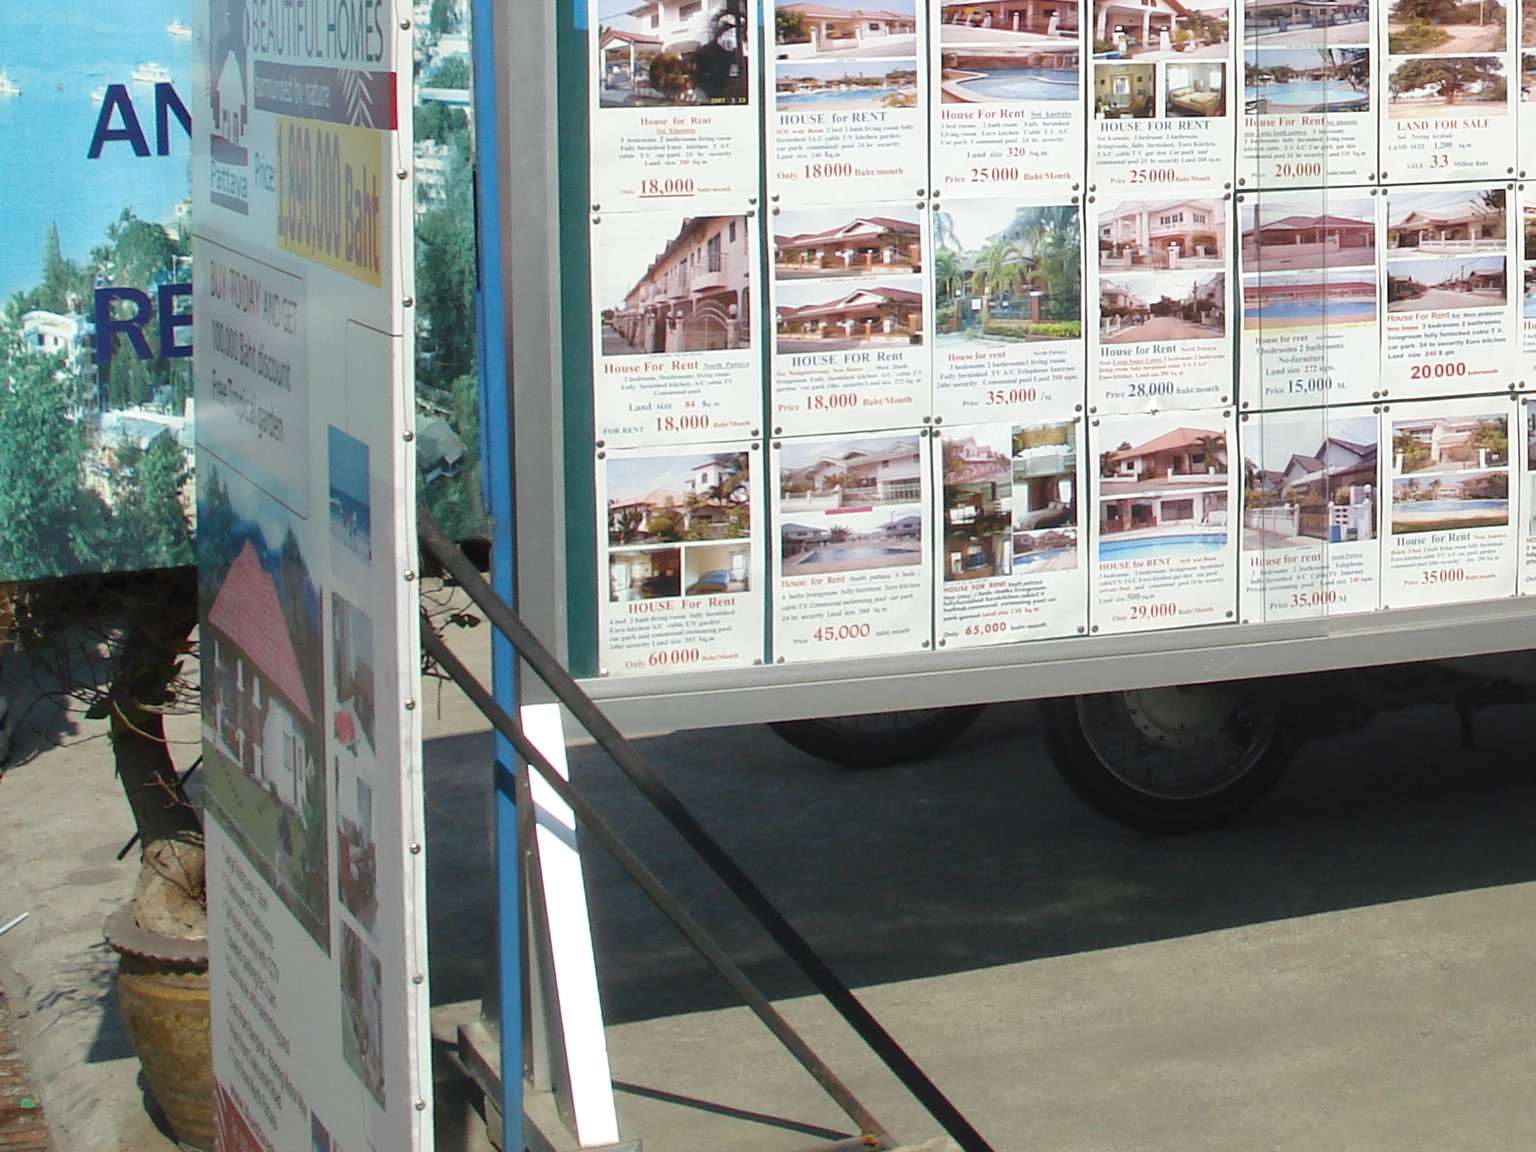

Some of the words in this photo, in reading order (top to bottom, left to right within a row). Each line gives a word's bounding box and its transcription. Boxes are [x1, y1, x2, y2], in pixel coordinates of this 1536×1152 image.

[326, 0, 384, 64] HOMES
[87, 82, 192, 160] AN
[780, 113, 826, 125] HOUSE
[832, 113, 849, 123] for
[852, 112, 887, 123] RENT
[941, 110, 967, 120] House
[978, 109, 996, 119] For
[1000, 109, 1024, 118] Rent
[1279, 117, 1296, 126] For
[1100, 122, 1142, 132] HOUSE
[1148, 121, 1172, 131] FOR
[1178, 120, 1210, 131] RENT
[1397, 120, 1429, 131] LAND
[1435, 119, 1458, 129] FOR
[1463, 119, 1491, 129] SALE
[1274, 163, 1321, 178] 20,000
[211, 160, 247, 199] Pattaya
[639, 178, 694, 197] 18,000
[345, 163, 379, 275] Baht
[229, 269, 261, 318] TODAY
[94, 284, 193, 363] RE
[1387, 313, 1413, 322] House
[1416, 312, 1430, 321] For
[1431, 312, 1450, 320] Rent
[1100, 346, 1132, 357] House
[1136, 345, 1150, 355] for
[1153, 344, 1176, 354] Rent
[792, 354, 837, 367] HOUSE
[844, 353, 870, 364] FOR
[877, 351, 903, 362] Rent
[604, 363, 641, 374] House
[644, 362, 666, 373] For
[672, 361, 698, 371] Rent
[1288, 378, 1332, 393] 15,000
[805, 393, 857, 411] 18,000
[986, 388, 1036, 406] 35,000
[655, 415, 709, 432] 18,000
[1397, 536, 1426, 547] House
[1431, 534, 1444, 543] for
[1448, 532, 1470, 542] Rent
[1099, 561, 1131, 571] HOUSE
[1133, 560, 1144, 568] for
[1146, 558, 1172, 567] RENT
[1250, 555, 1281, 567] House
[1283, 554, 1298, 564] for
[1301, 552, 1321, 562] rent
[781, 578, 806, 588] House
[811, 577, 823, 586] for
[628, 600, 674, 614] HOUSE
[682, 599, 702, 610] For
[708, 597, 735, 608] Rent
[1290, 591, 1336, 608] 35,000
[1129, 602, 1176, 620] 29,000
[813, 623, 871, 642] 45,000
[965, 622, 1007, 636] 65,000
